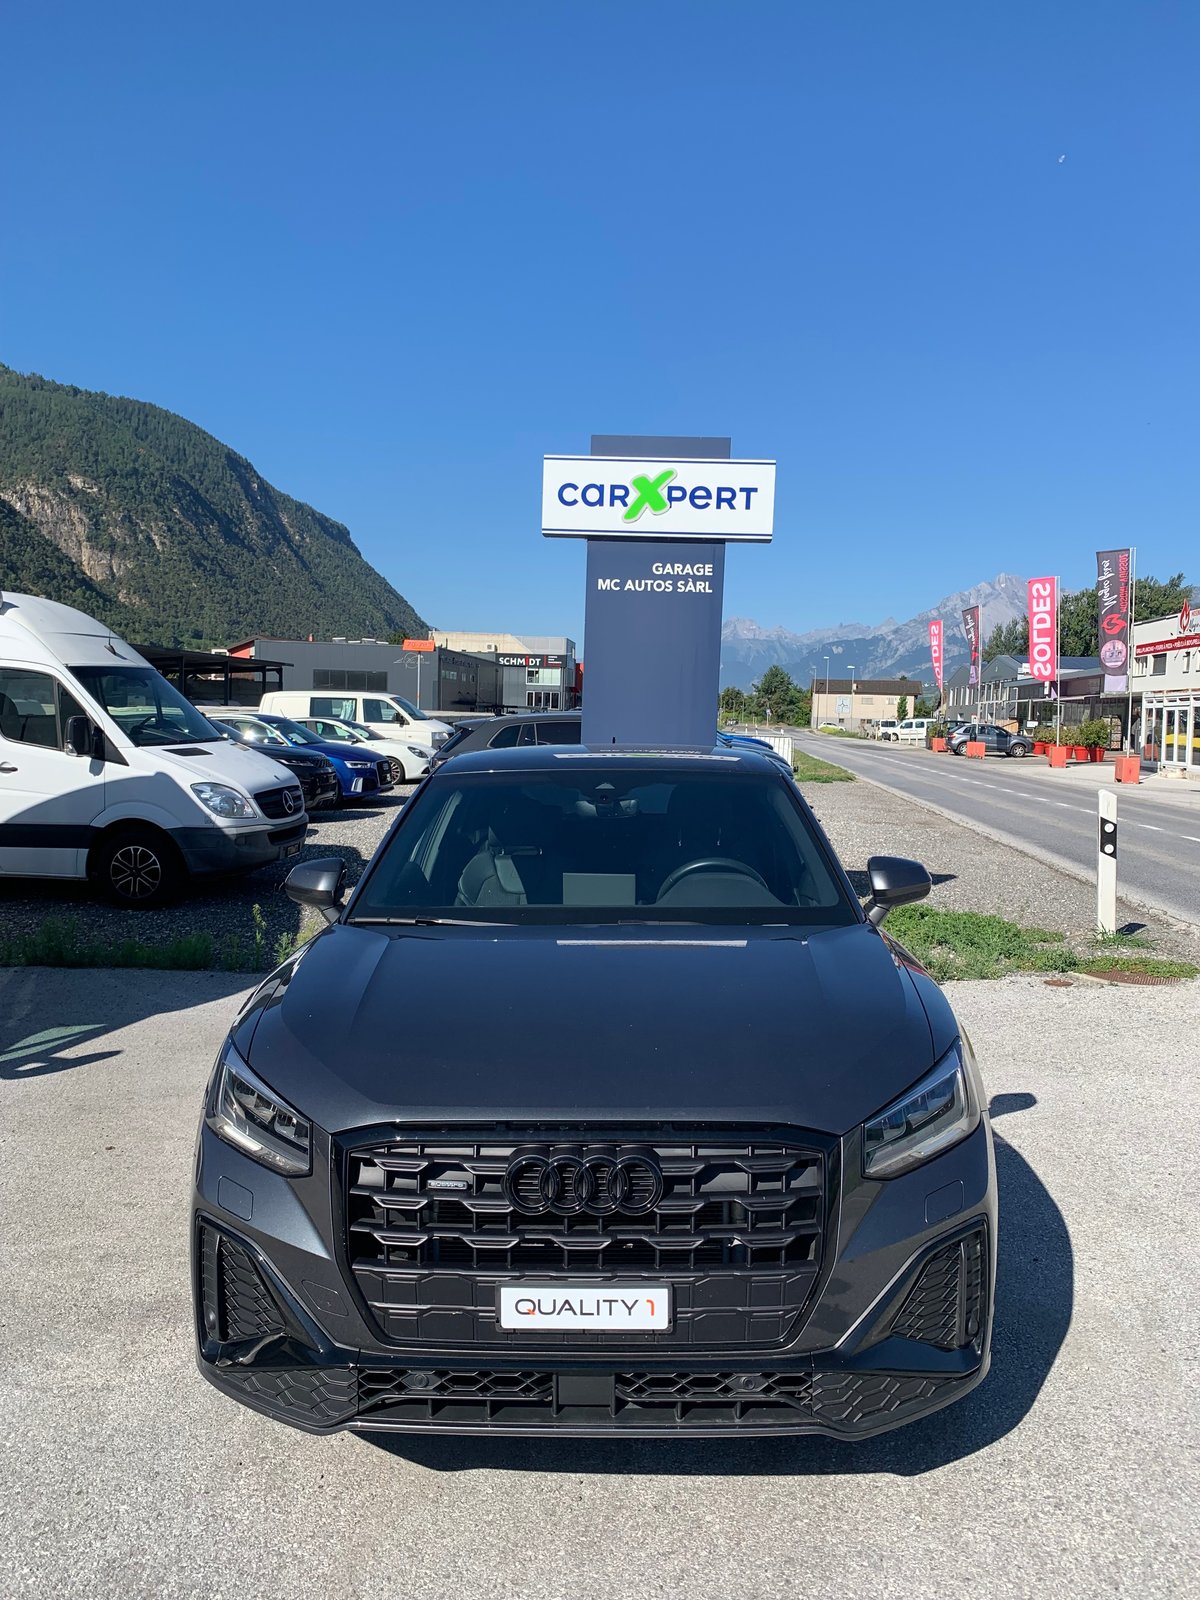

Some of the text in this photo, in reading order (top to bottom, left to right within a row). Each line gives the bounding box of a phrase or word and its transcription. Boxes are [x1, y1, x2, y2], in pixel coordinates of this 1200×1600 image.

[652, 562, 714, 576] GARAGE
[597, 578, 713, 593] MC AUTOS SÀRL
[498, 655, 542, 666] SCHMIDT
[514, 1298, 655, 1318] QUALITY 1
